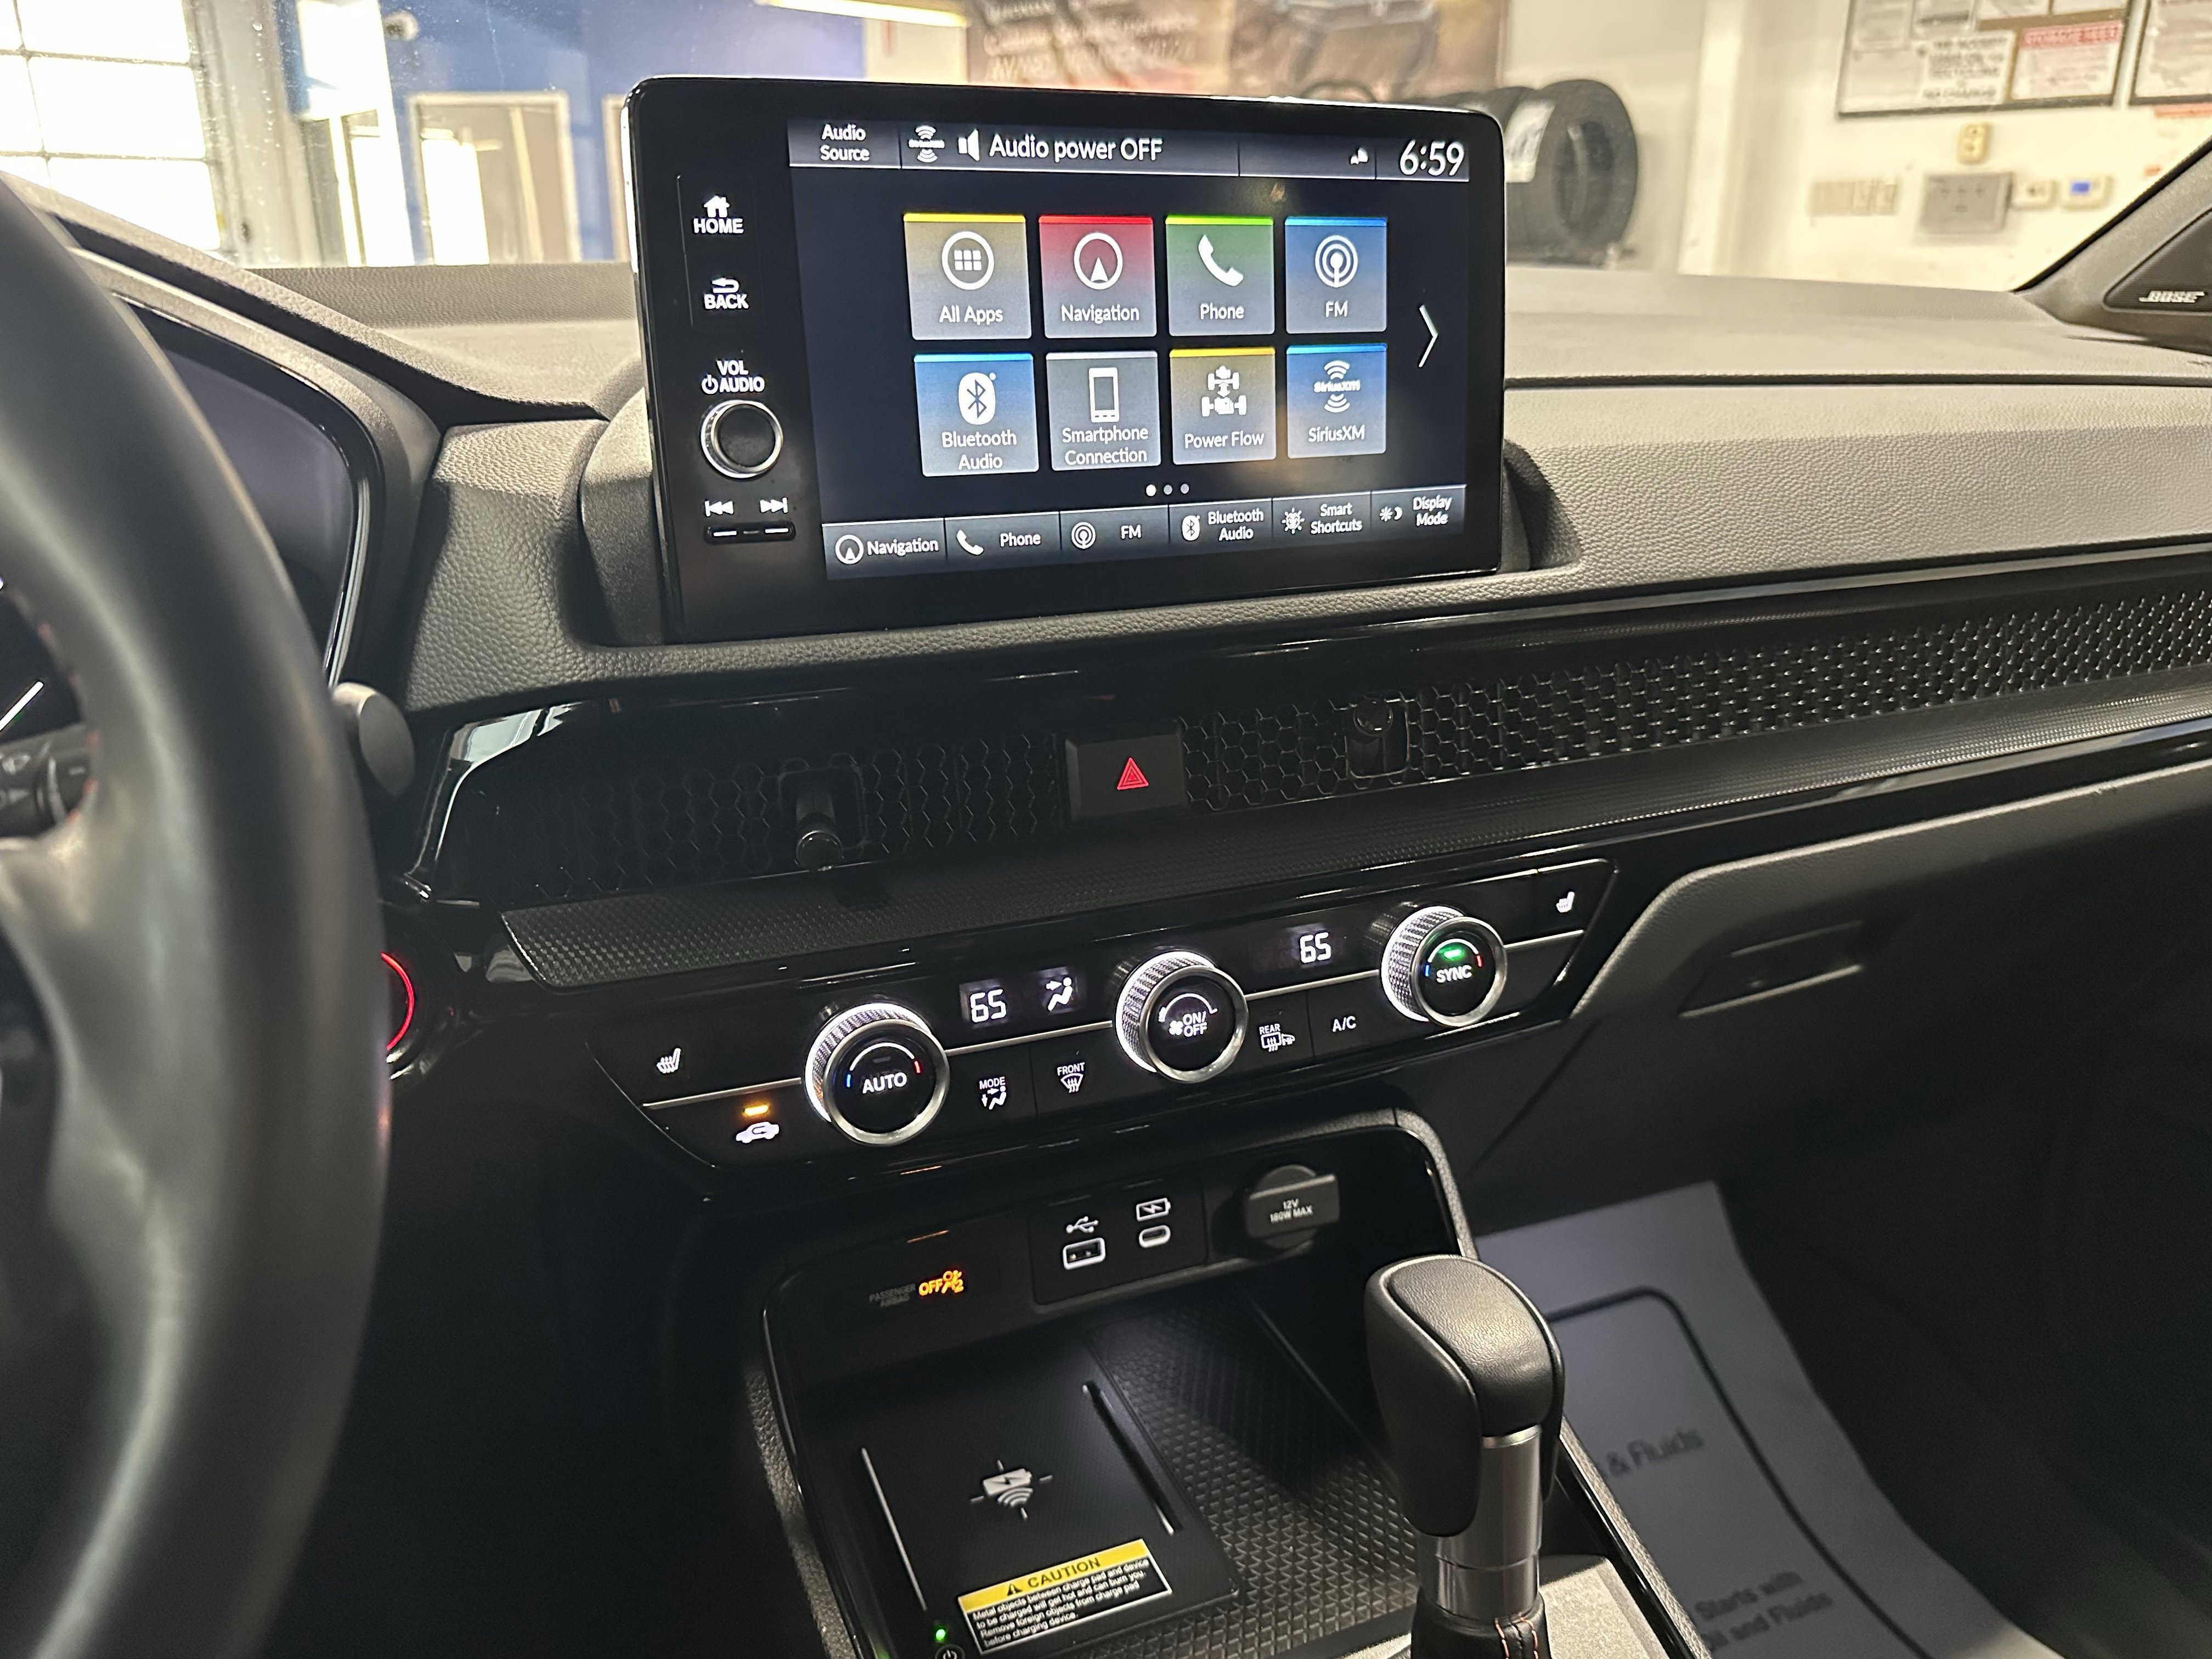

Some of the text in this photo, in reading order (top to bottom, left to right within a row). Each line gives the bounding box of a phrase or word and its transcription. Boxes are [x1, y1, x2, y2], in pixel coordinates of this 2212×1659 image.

[821, 124, 866, 142] Audio
[820, 145, 870, 162] Source
[989, 134, 1164, 163] Audio power OFF
[1400, 139, 1465, 176] 6:59
[693, 218, 744, 234] HOME
[704, 294, 749, 311] BACK
[2138, 290, 2205, 303] BOSE
[939, 305, 1003, 326] All Apps
[1061, 304, 1139, 325] Navigation
[1200, 302, 1244, 320] Phone
[1325, 301, 1348, 318] FM
[716, 359, 749, 376] VOL
[719, 376, 765, 393] AUDIO
[941, 429, 1017, 448] Bluetooth
[1062, 425, 1149, 445] Smartphone
[1184, 431, 1265, 449] Power Flow
[1308, 425, 1365, 443] SiriusXM
[958, 453, 1003, 471] Audio
[1064, 449, 1148, 466] Connection
[1320, 503, 1352, 517] Smart
[1413, 495, 1453, 512] Display
[1207, 508, 1264, 526] Bluetooth
[1310, 517, 1363, 535] Shortcuts
[1416, 511, 1448, 527] Mode
[1000, 532, 1041, 548] Phone
[1121, 524, 1142, 539] FM
[1218, 526, 1254, 541] Audio
[867, 537, 939, 557] Navigation
[1299, 932, 1332, 964] 65
[1436, 964, 1472, 984] SYNC
[969, 988, 1007, 1023] 65
[1183, 1011, 1206, 1026] ON/
[1332, 1015, 1357, 1032] A/C
[1183, 1023, 1207, 1037] OFF
[1259, 1023, 1281, 1035] REAR
[1057, 1062, 1086, 1076] FRONT
[861, 1071, 907, 1094] AUTO
[979, 1076, 1006, 1090] MODE
[1283, 1198, 1299, 1210] 12V
[1293, 1205, 1314, 1218] MAX
[919, 1278, 943, 1296] OFF
[1028, 1557, 1101, 1588] CAUTION
[972, 1559, 1149, 1621] Metal objects between charge pad and device
[977, 1570, 1147, 1630] to be charged will get hot and can burn you.
[980, 1579, 1140, 1638] Remove foreign objects from charge pad
[984, 1612, 1079, 1647] before charging device.
